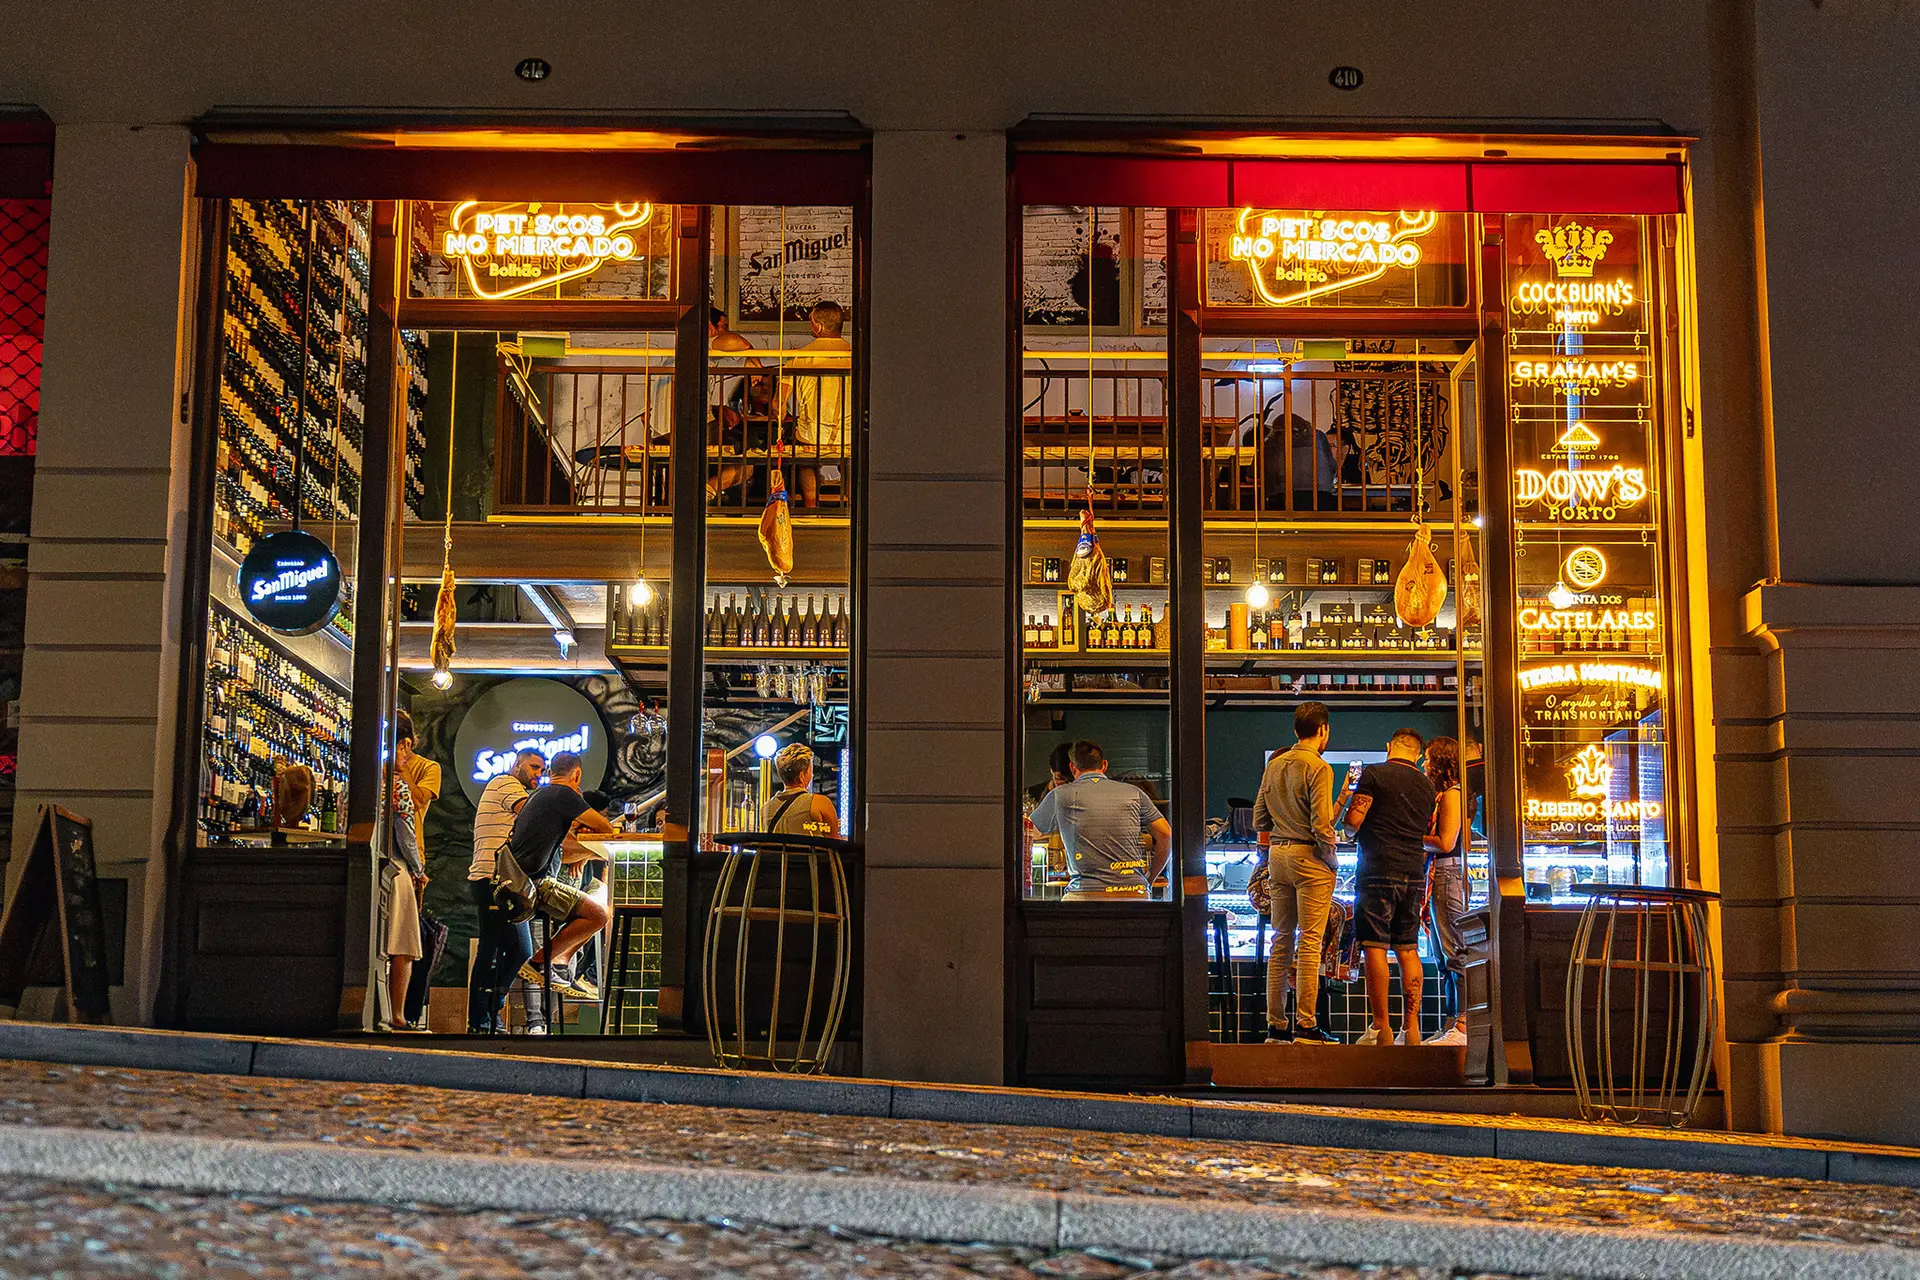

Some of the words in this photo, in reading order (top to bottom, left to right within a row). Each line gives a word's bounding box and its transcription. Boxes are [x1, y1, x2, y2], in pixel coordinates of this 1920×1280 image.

[446, 234, 488, 255] NO
[496, 236, 633, 257] MERCADO
[1232, 237, 1274, 258] NO
[1283, 240, 1419, 265] MERCADO
[489, 262, 541, 277] Bolhão
[1275, 267, 1328, 282] Bolhão
[1518, 279, 1633, 304] COCKBURN'S
[1555, 310, 1599, 323] PORTO
[1515, 361, 1638, 379] GRAHAM'S
[1553, 387, 1600, 396] PORTO
[1516, 465, 1647, 501] DOW'S
[1548, 506, 1616, 521] PORTO
[1599, 594, 1622, 605] DOS
[1518, 608, 1655, 630] CASTELARES
[1545, 694, 1557, 708] O
[1560, 695, 1597, 713] orgulho
[1600, 694, 1613, 708] de
[1534, 710, 1642, 721] TRANSMONTANO
[1527, 799, 1597, 817] RIBEIRO
[1601, 799, 1661, 817] SANTO
[1551, 822, 1574, 832] DÃO
